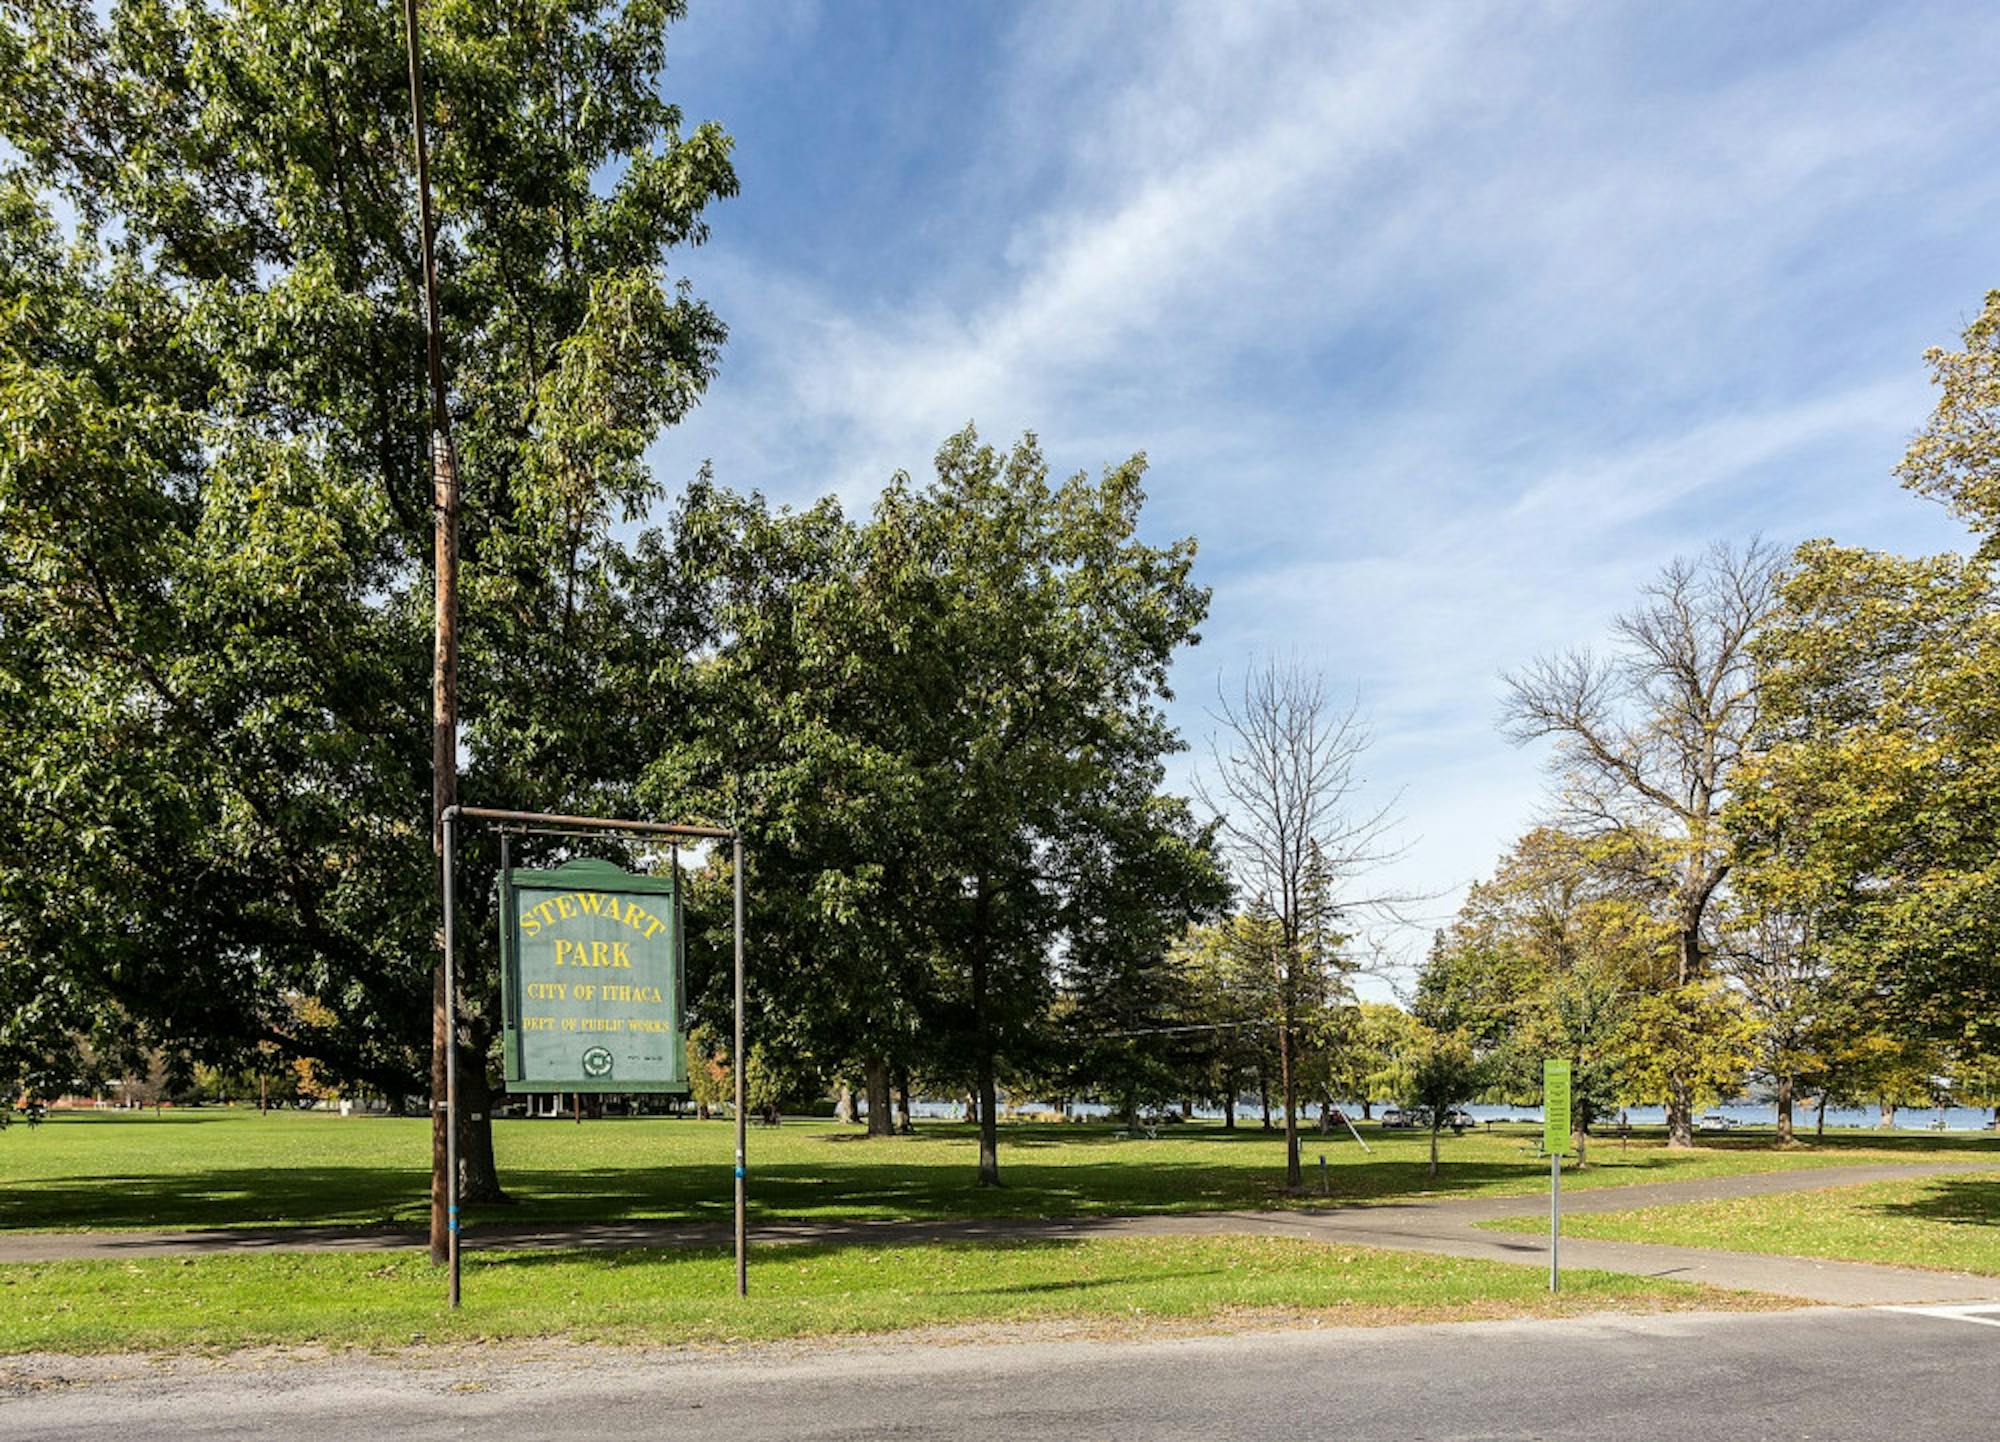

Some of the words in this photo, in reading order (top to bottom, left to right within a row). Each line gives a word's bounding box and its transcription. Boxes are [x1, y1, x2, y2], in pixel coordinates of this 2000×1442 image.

[519, 893, 666, 940] STEWART
[554, 939, 631, 969] PARK
[527, 983, 567, 1001] CITY
[573, 984, 596, 1001] OF
[601, 984, 662, 1003] ITHACA
[561, 1018, 577, 1031] OF
